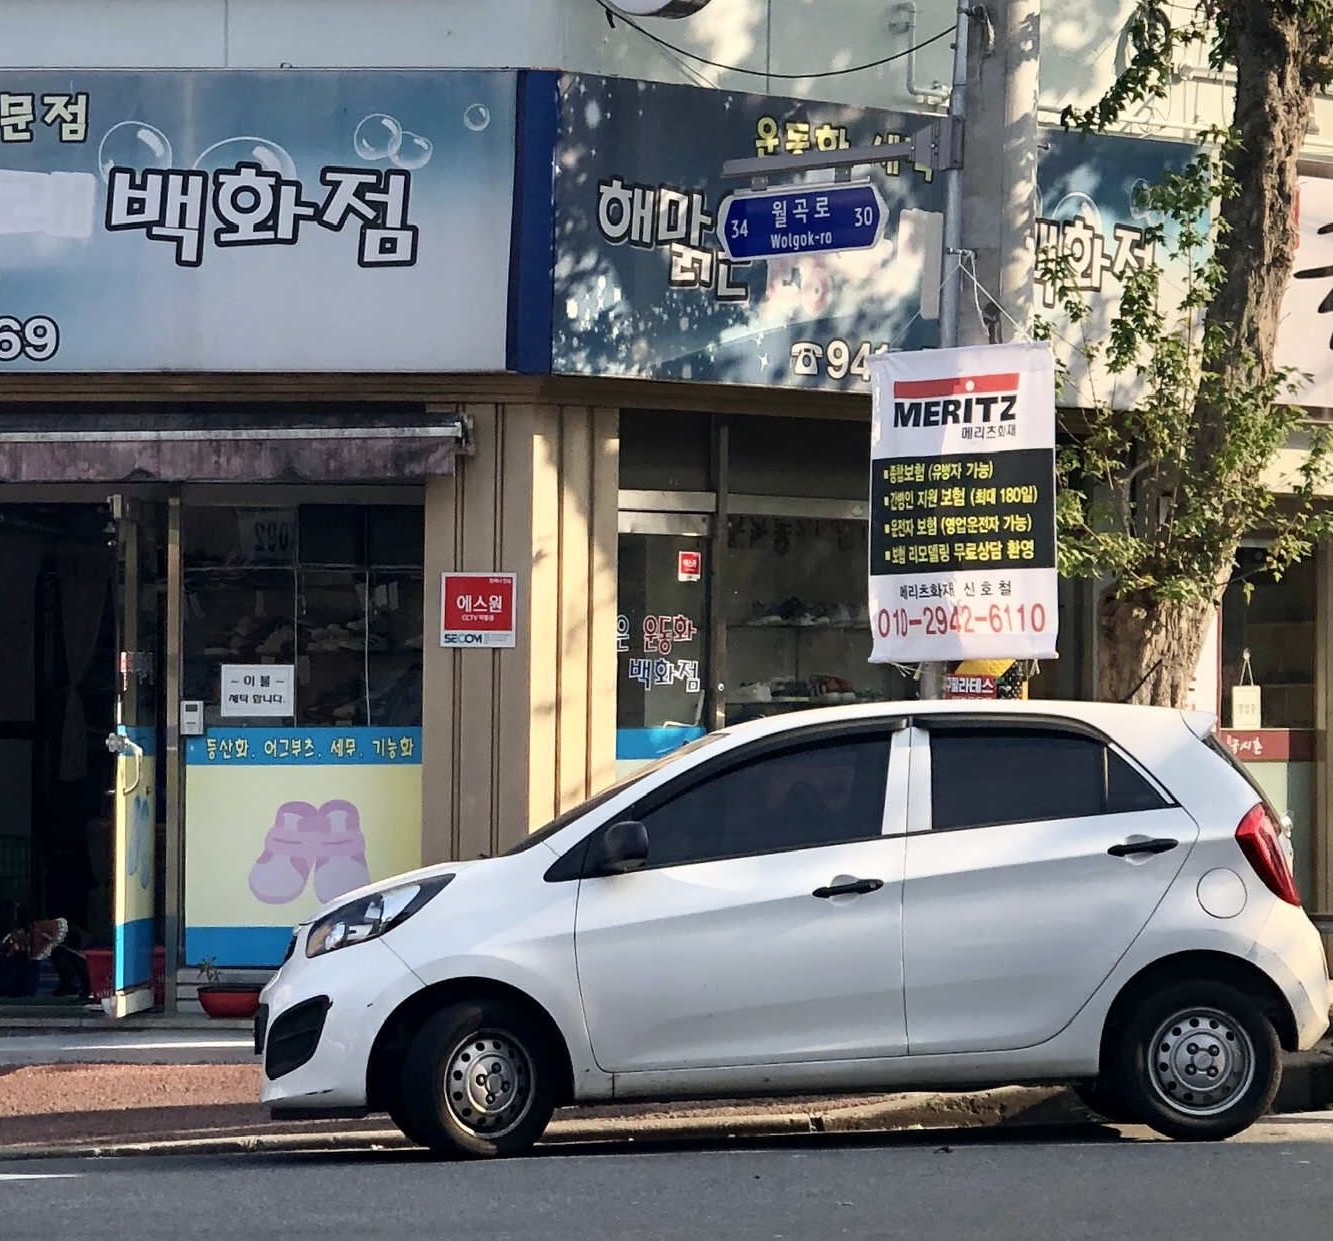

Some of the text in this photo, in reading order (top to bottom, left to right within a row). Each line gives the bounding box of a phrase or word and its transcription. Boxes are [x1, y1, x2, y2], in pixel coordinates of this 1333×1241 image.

[106, 162, 419, 267] 백화점
[731, 196, 874, 239] 34 월곡로 30
[771, 231, 833, 251] Wolgok-ro
[826, 338, 889, 382] 94
[894, 395, 1018, 428] MERITZ
[962, 424, 1016, 440] 메리츠화재
[889, 463, 925, 484] 종합보험
[966, 460, 994, 480] 가능)
[890, 484, 1038, 511] 간병인 지원 보험 (최대 180일)
[891, 518, 914, 538] 운전자
[917, 516, 937, 536] 보험
[941, 514, 999, 536] (영업운전자
[1003, 513, 1032, 533] 가능)
[892, 539, 1035, 565] 보험 리모델링 무료상담 환영
[899, 581, 955, 600] 메리츠화재
[456, 595, 502, 613] 에스원
[877, 602, 1046, 638] 010-2942-6110
[444, 633, 483, 644] SECOM
[643, 614, 697, 655] 운동화
[629, 658, 701, 693] 백화점
[372, 737, 414, 760] 기능화
